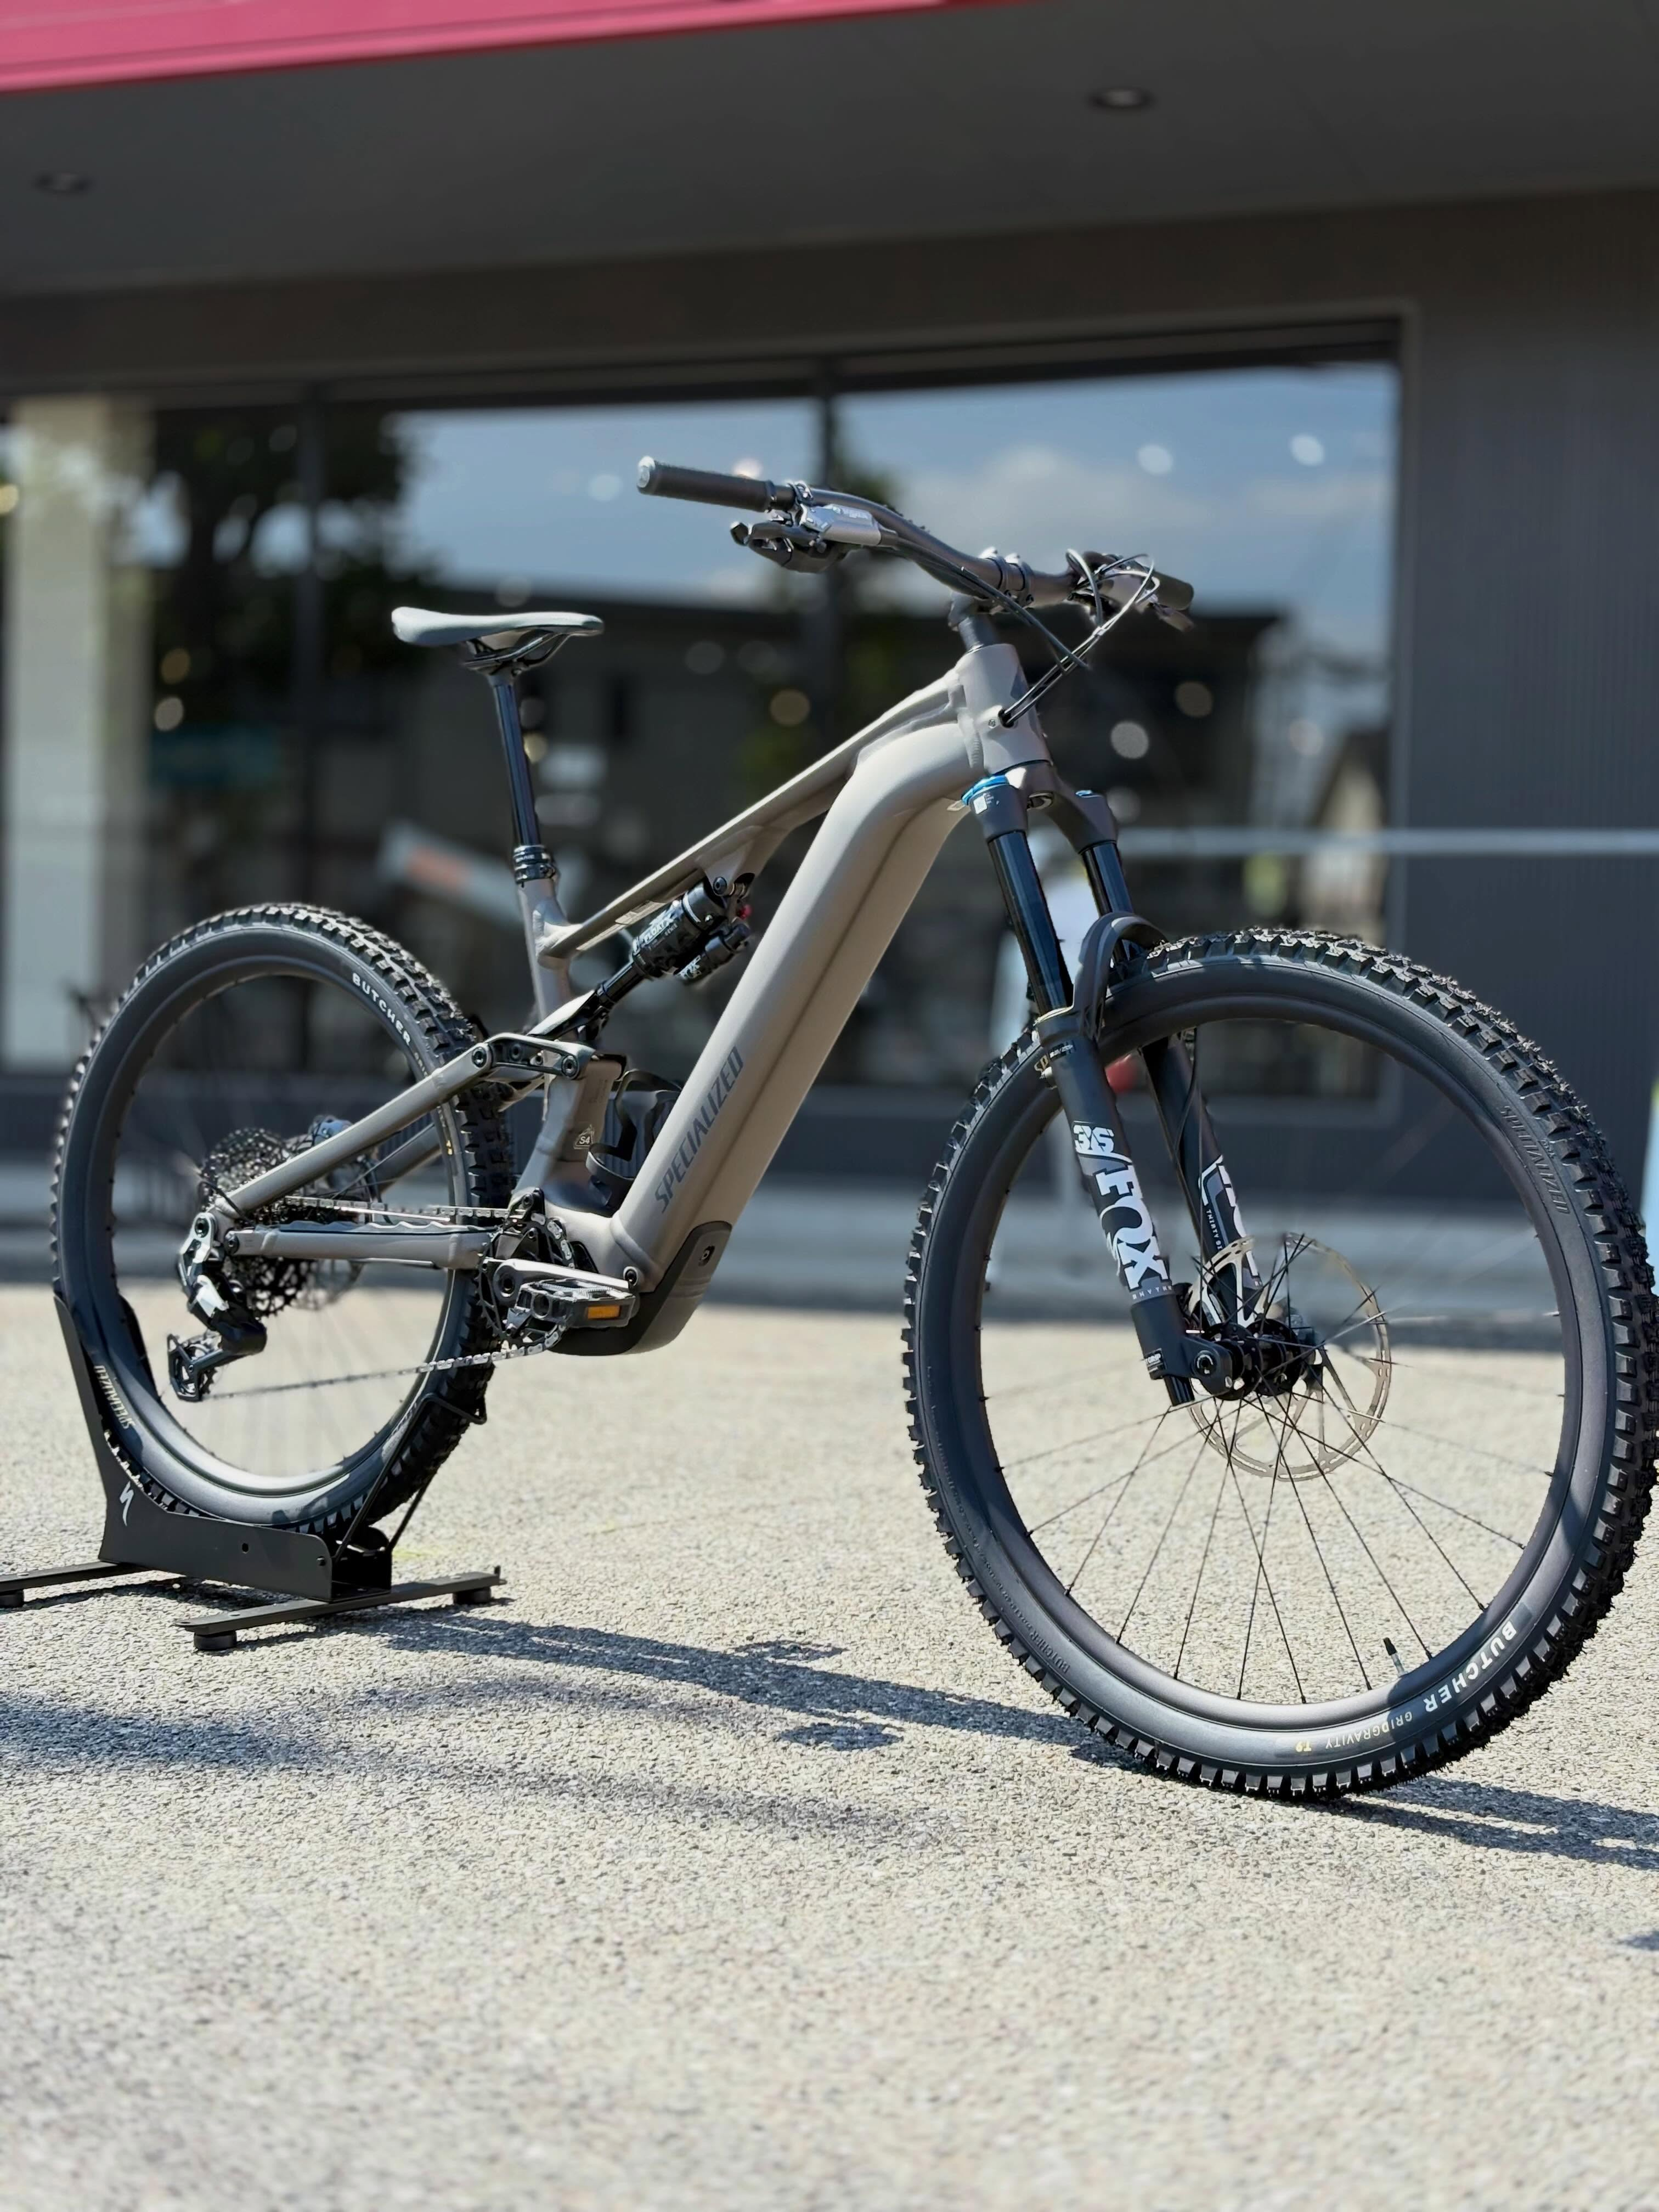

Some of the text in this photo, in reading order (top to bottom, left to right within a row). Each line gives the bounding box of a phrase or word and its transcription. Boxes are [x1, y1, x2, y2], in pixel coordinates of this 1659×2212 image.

[352, 973, 411, 1045] BUTCHER
[579, 1136, 590, 1144] S4
[655, 1046, 743, 1214] SPECIALIZED
[1096, 1164, 1169, 1290] FOX
[1425, 1620, 1517, 1712] BUTCHER
